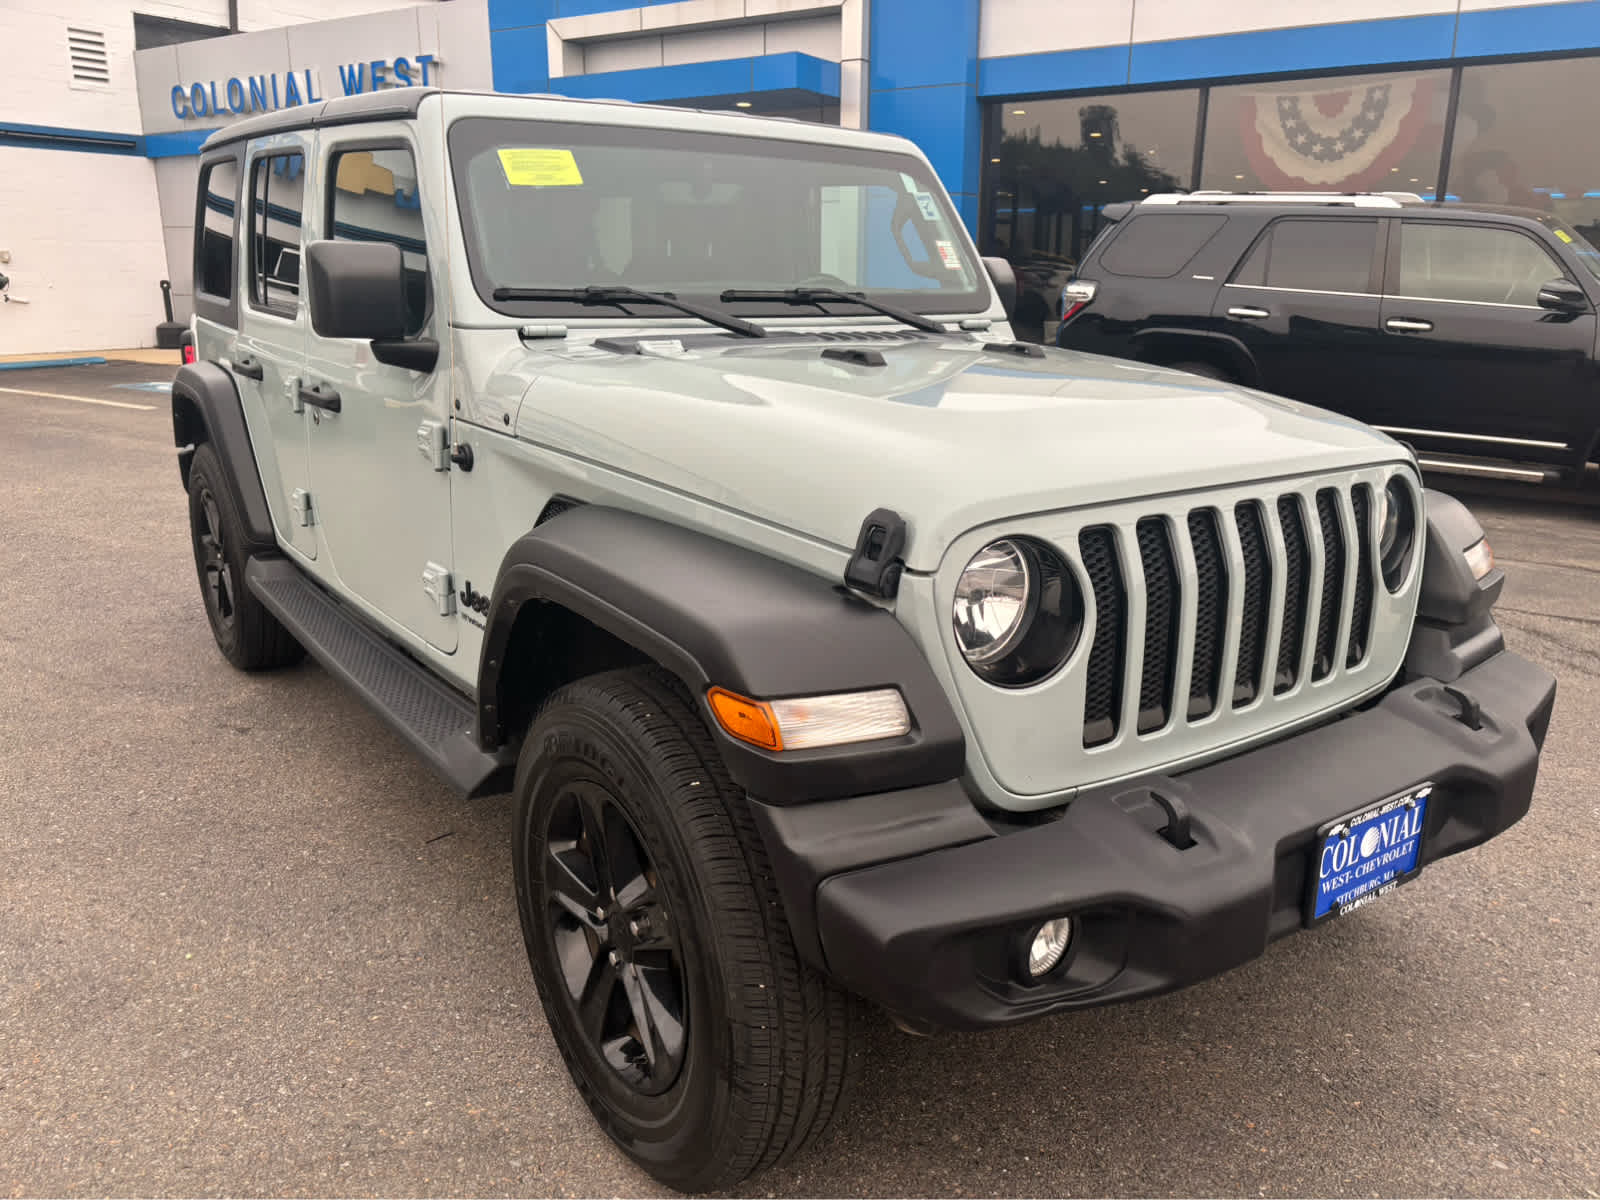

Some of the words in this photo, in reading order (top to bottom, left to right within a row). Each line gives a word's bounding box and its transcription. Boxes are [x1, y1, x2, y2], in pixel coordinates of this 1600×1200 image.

[171, 69, 322, 120] COLONIAL
[339, 55, 434, 97] WEST
[460, 580, 490, 617] Jee
[1320, 806, 1421, 878] COLONIAL
[1355, 840, 1414, 878] CHEVROLET
[1340, 891, 1377, 916] COLONIAL
